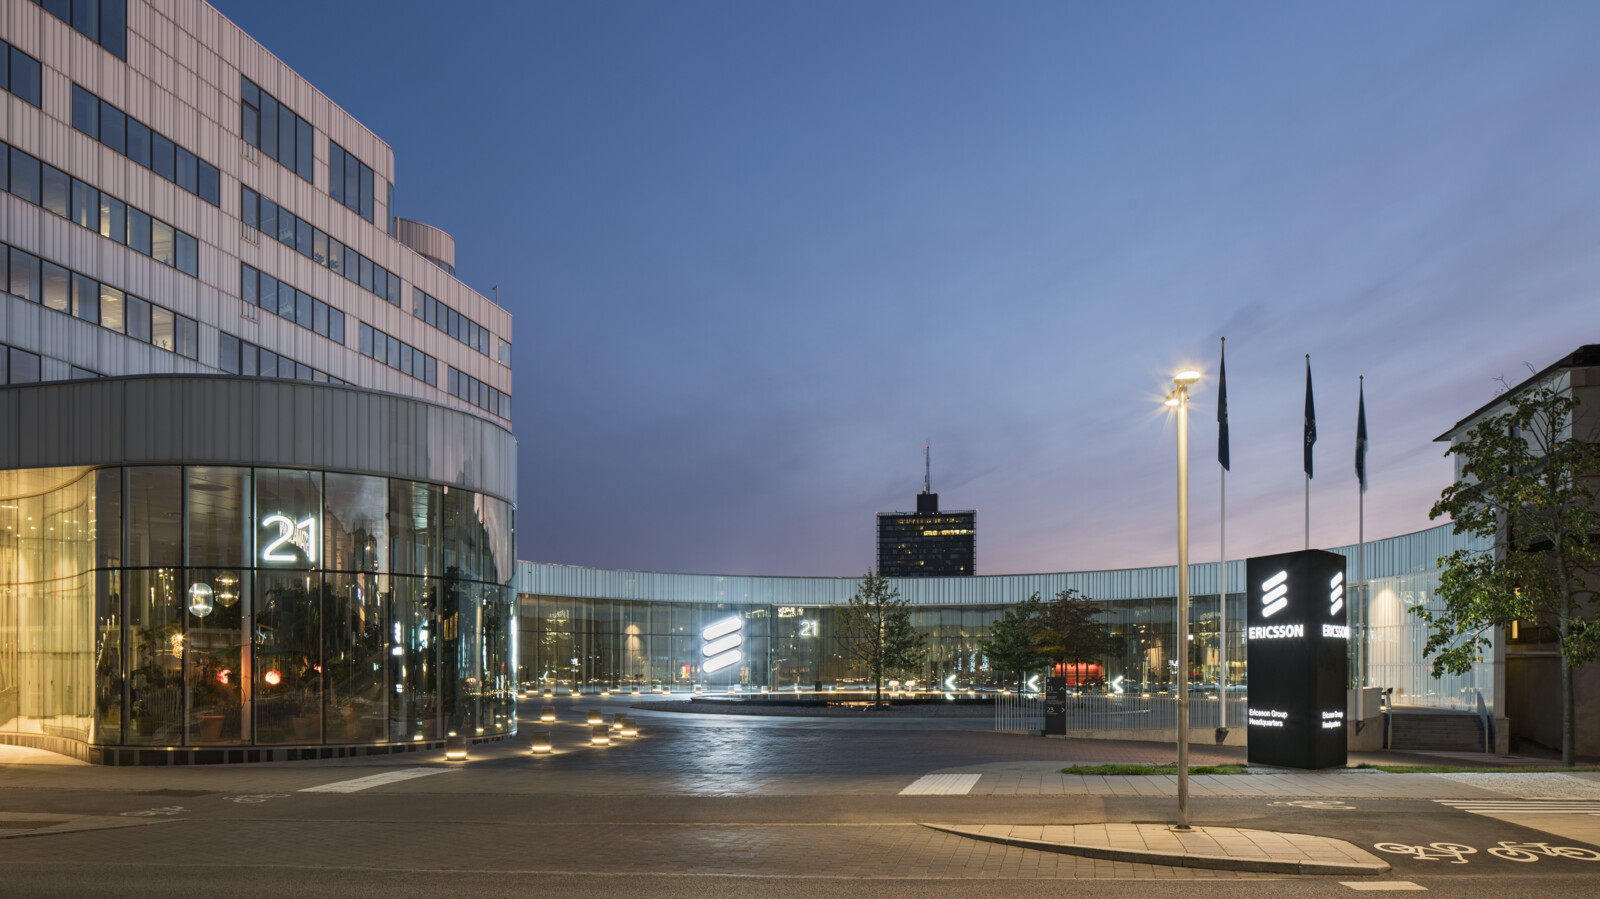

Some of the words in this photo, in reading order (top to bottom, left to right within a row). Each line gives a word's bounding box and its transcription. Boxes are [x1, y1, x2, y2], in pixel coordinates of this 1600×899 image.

[262, 515, 316, 562] 21
[800, 621, 817, 636] 21
[1248, 624, 1304, 639] ERICSSON
[1249, 709, 1270, 717] Ericsson
[1270, 709, 1288, 719] Group
[1249, 718, 1283, 727] Headquarters
